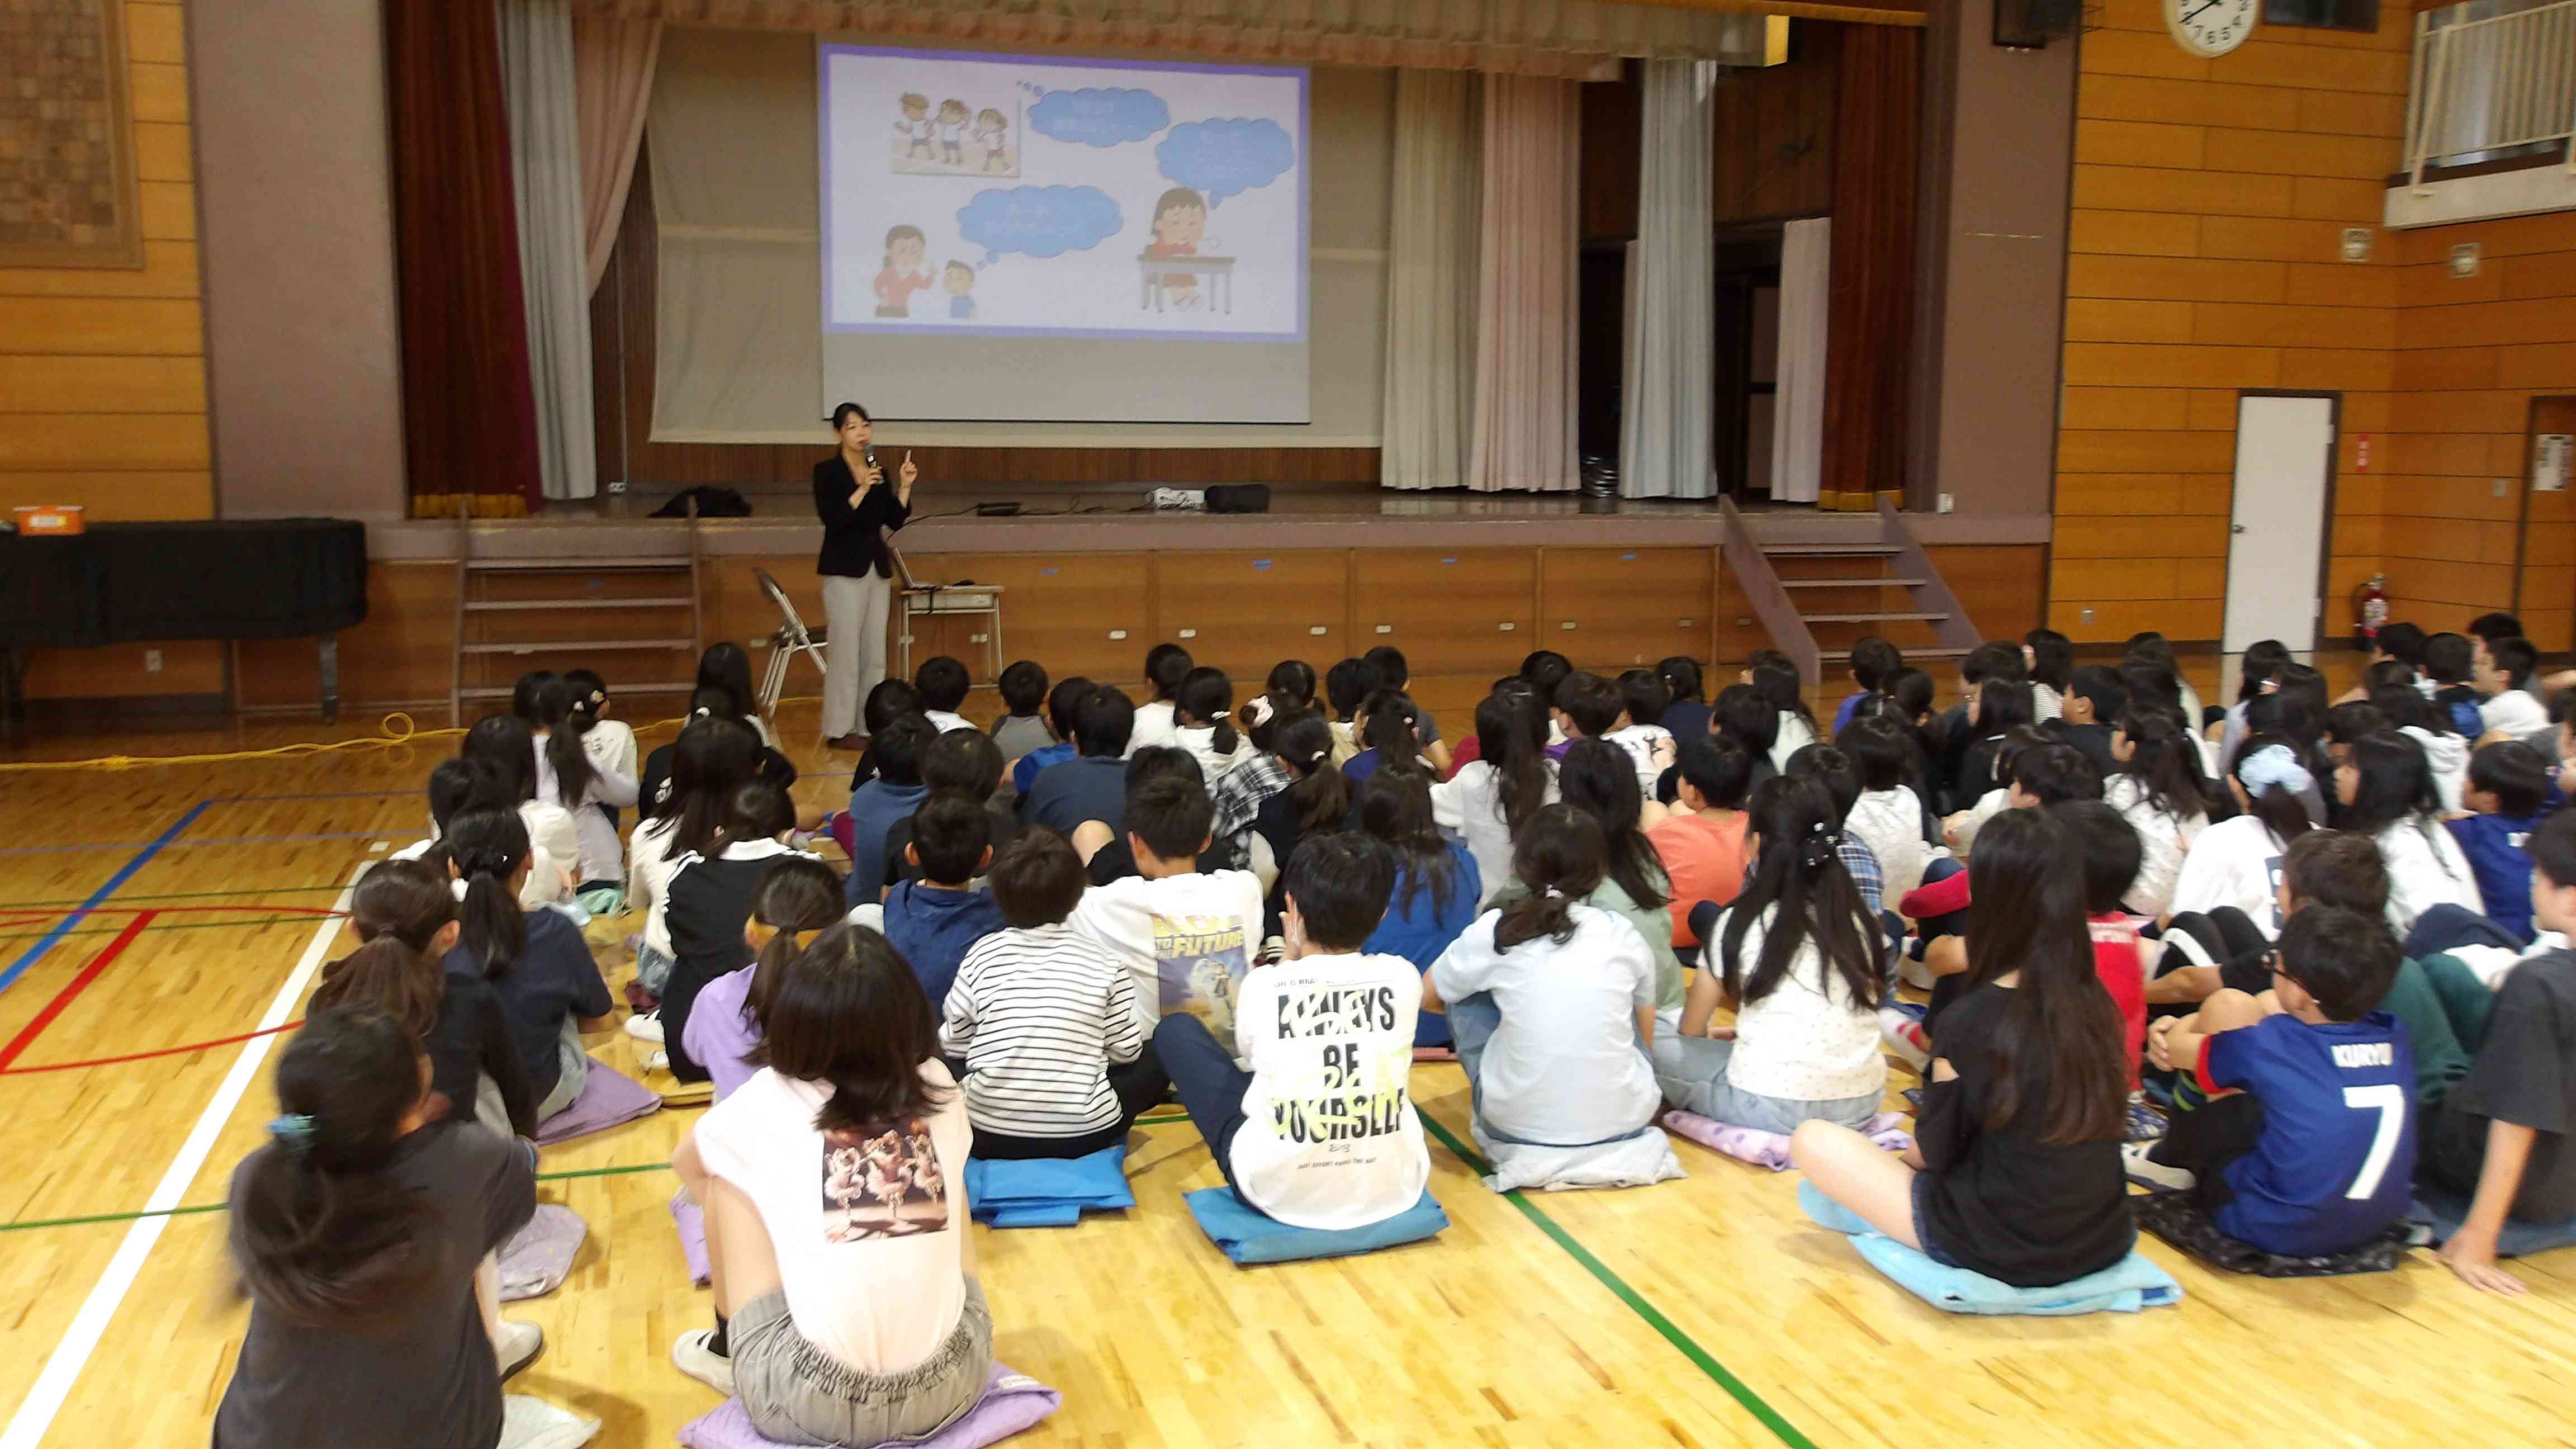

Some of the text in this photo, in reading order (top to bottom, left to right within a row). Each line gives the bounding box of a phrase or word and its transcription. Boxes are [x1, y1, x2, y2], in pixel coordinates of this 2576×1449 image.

[1172, 928, 1244, 958] FUTURE
[1323, 1043, 1361, 1088] BE
[2342, 1083, 2405, 1200] 7
